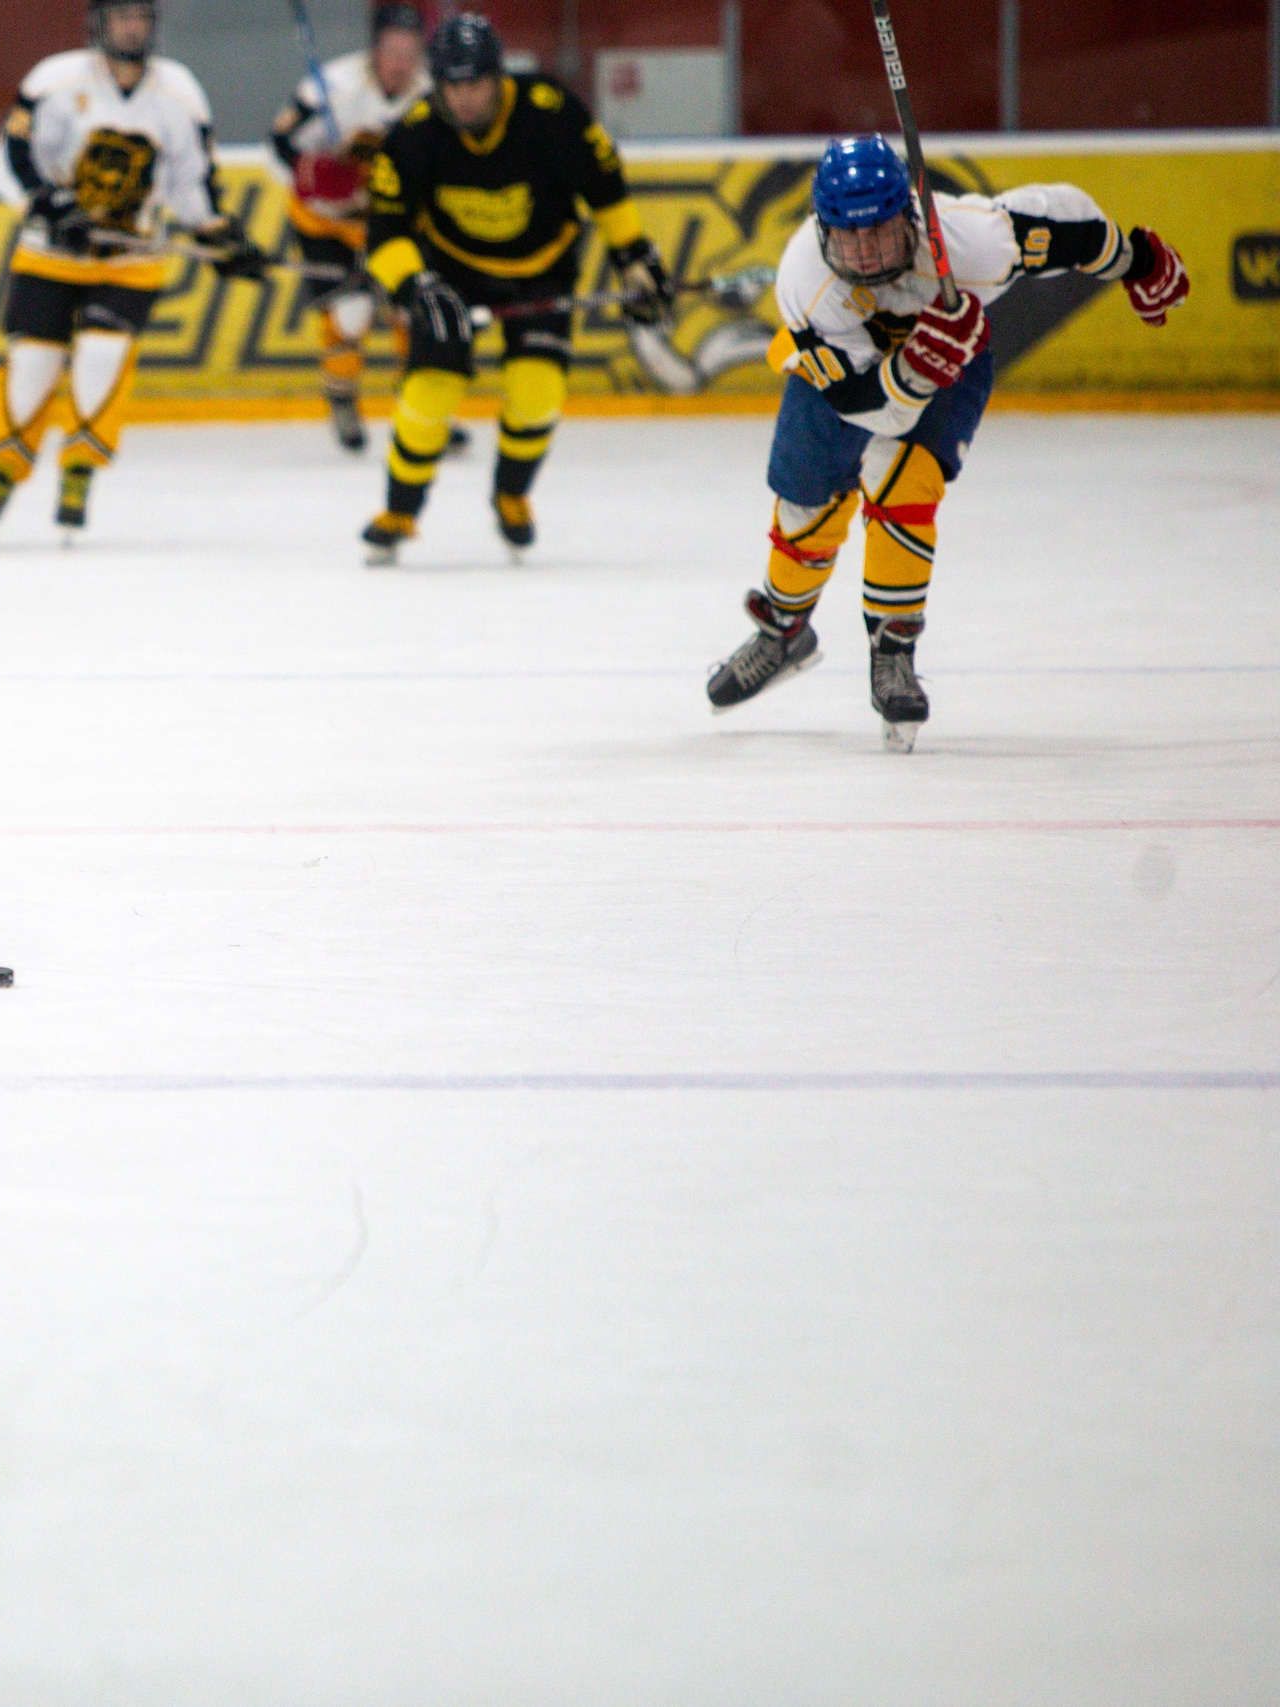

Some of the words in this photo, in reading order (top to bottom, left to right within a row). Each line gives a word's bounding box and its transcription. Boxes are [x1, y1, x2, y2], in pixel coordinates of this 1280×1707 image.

[874, 15, 907, 90] BAUER
[843, 285, 876, 319] 10
[800, 346, 846, 390] 10
